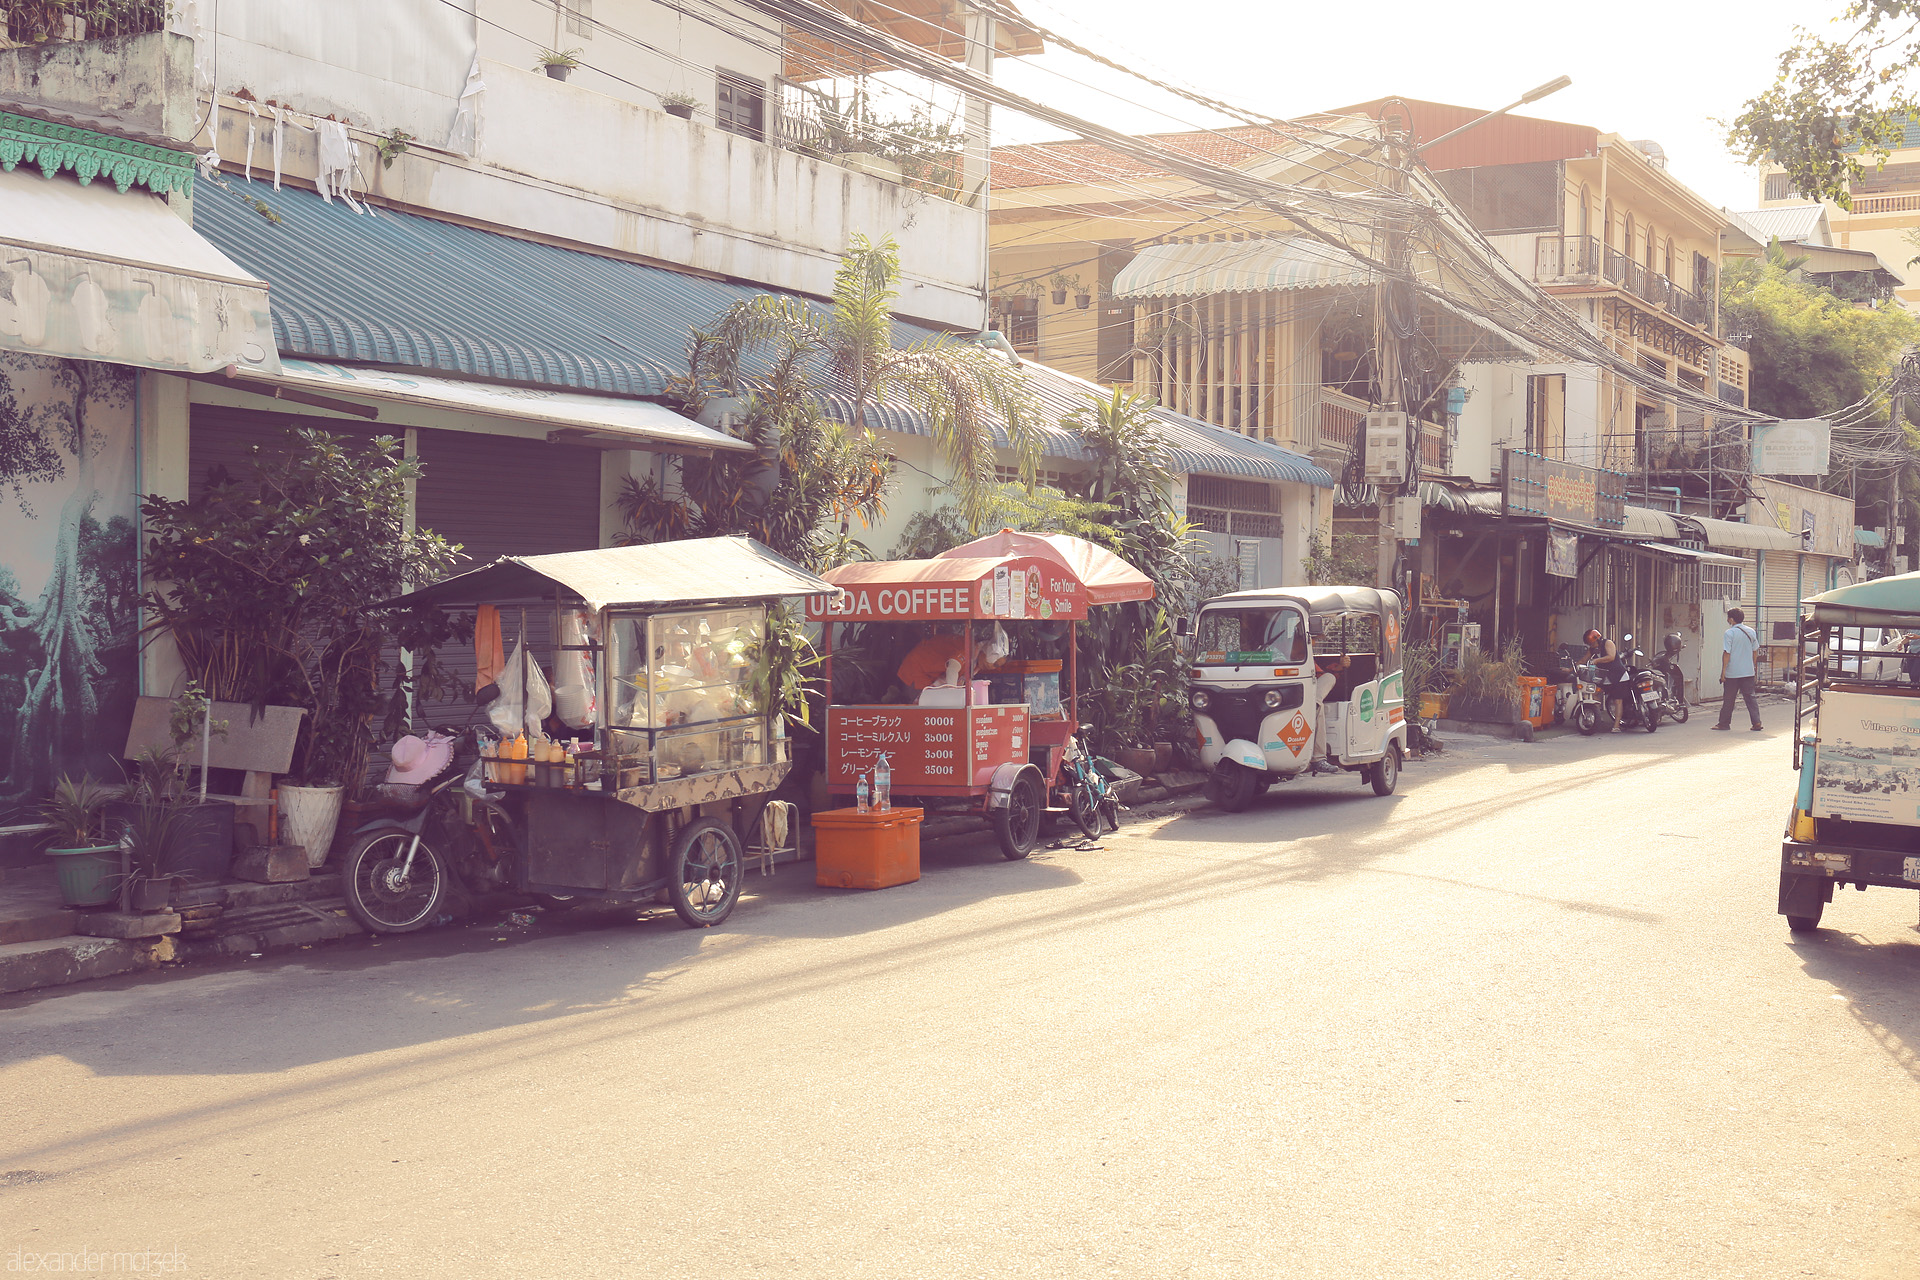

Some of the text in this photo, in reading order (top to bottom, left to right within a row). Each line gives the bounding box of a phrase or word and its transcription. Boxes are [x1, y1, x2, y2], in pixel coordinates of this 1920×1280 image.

[1050, 578, 1076, 592] For Your
[878, 588, 970, 614] COFFEE
[1055, 598, 1072, 613] Smile
[840, 715, 902, 727] コーヒーブラック
[1861, 719, 1898, 733] Village
[840, 731, 911, 743] コーヒーミルク入り
